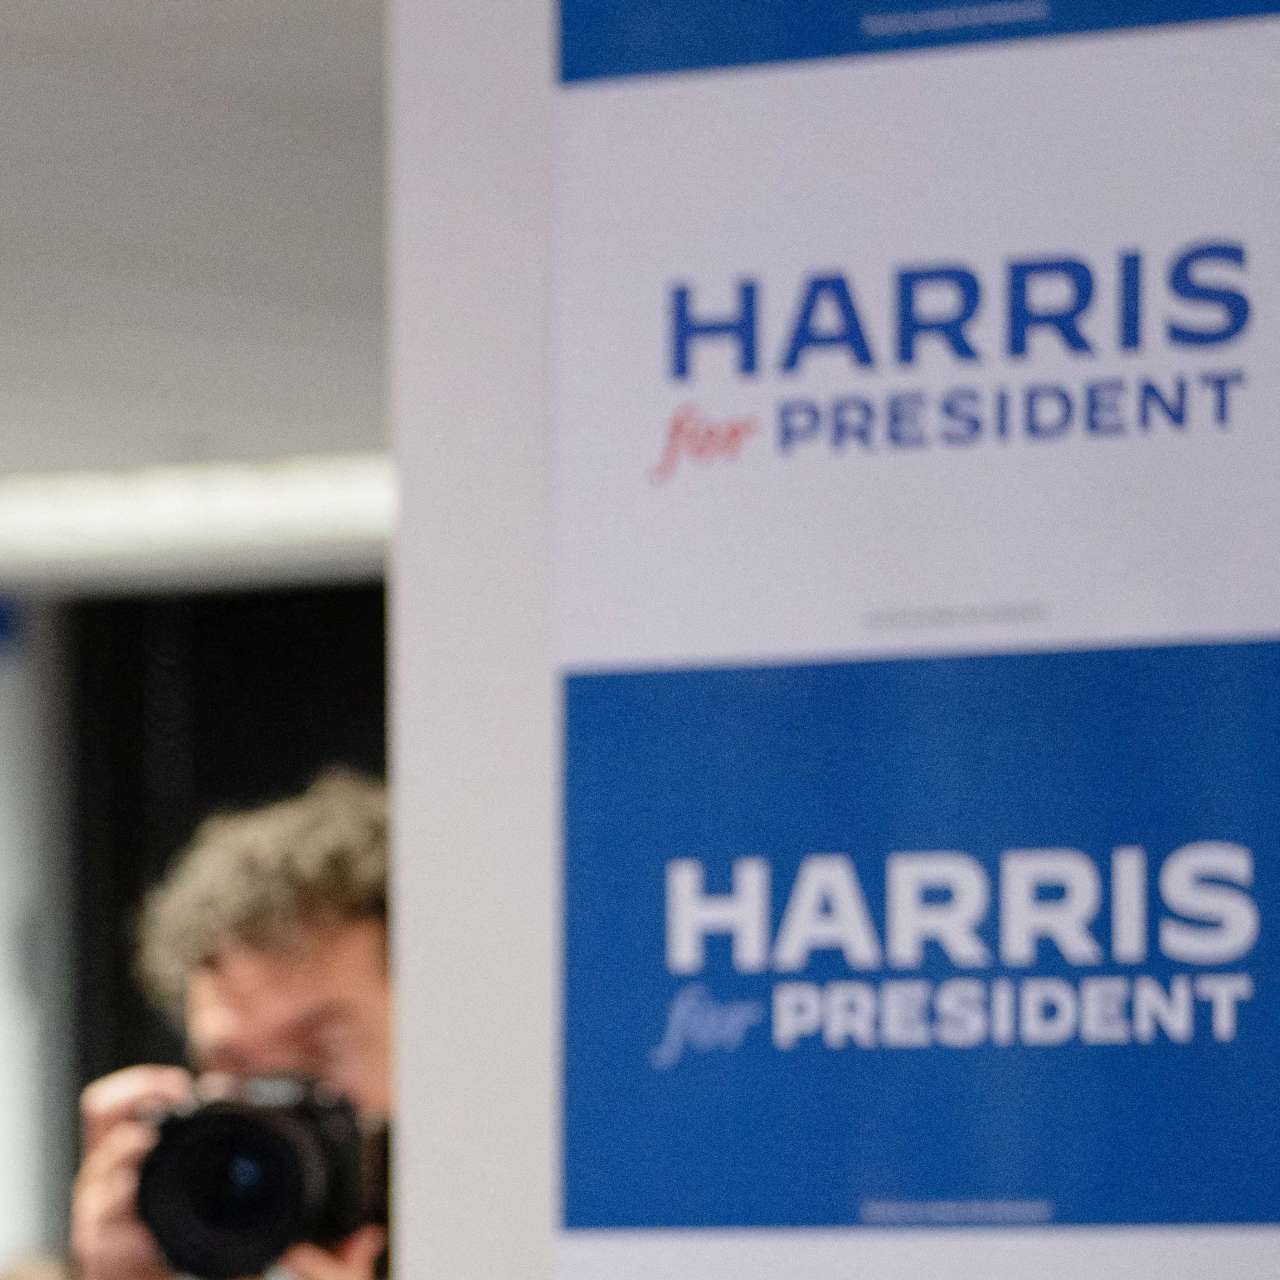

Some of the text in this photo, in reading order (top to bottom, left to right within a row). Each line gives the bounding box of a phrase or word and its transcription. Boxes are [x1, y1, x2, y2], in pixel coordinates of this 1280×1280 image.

[671, 241, 1252, 380] HARRIS
[653, 368, 1247, 482] for PRESIDENT
[667, 843, 1257, 973] HARRIS
[651, 976, 1251, 1068] for PRESIDENT
